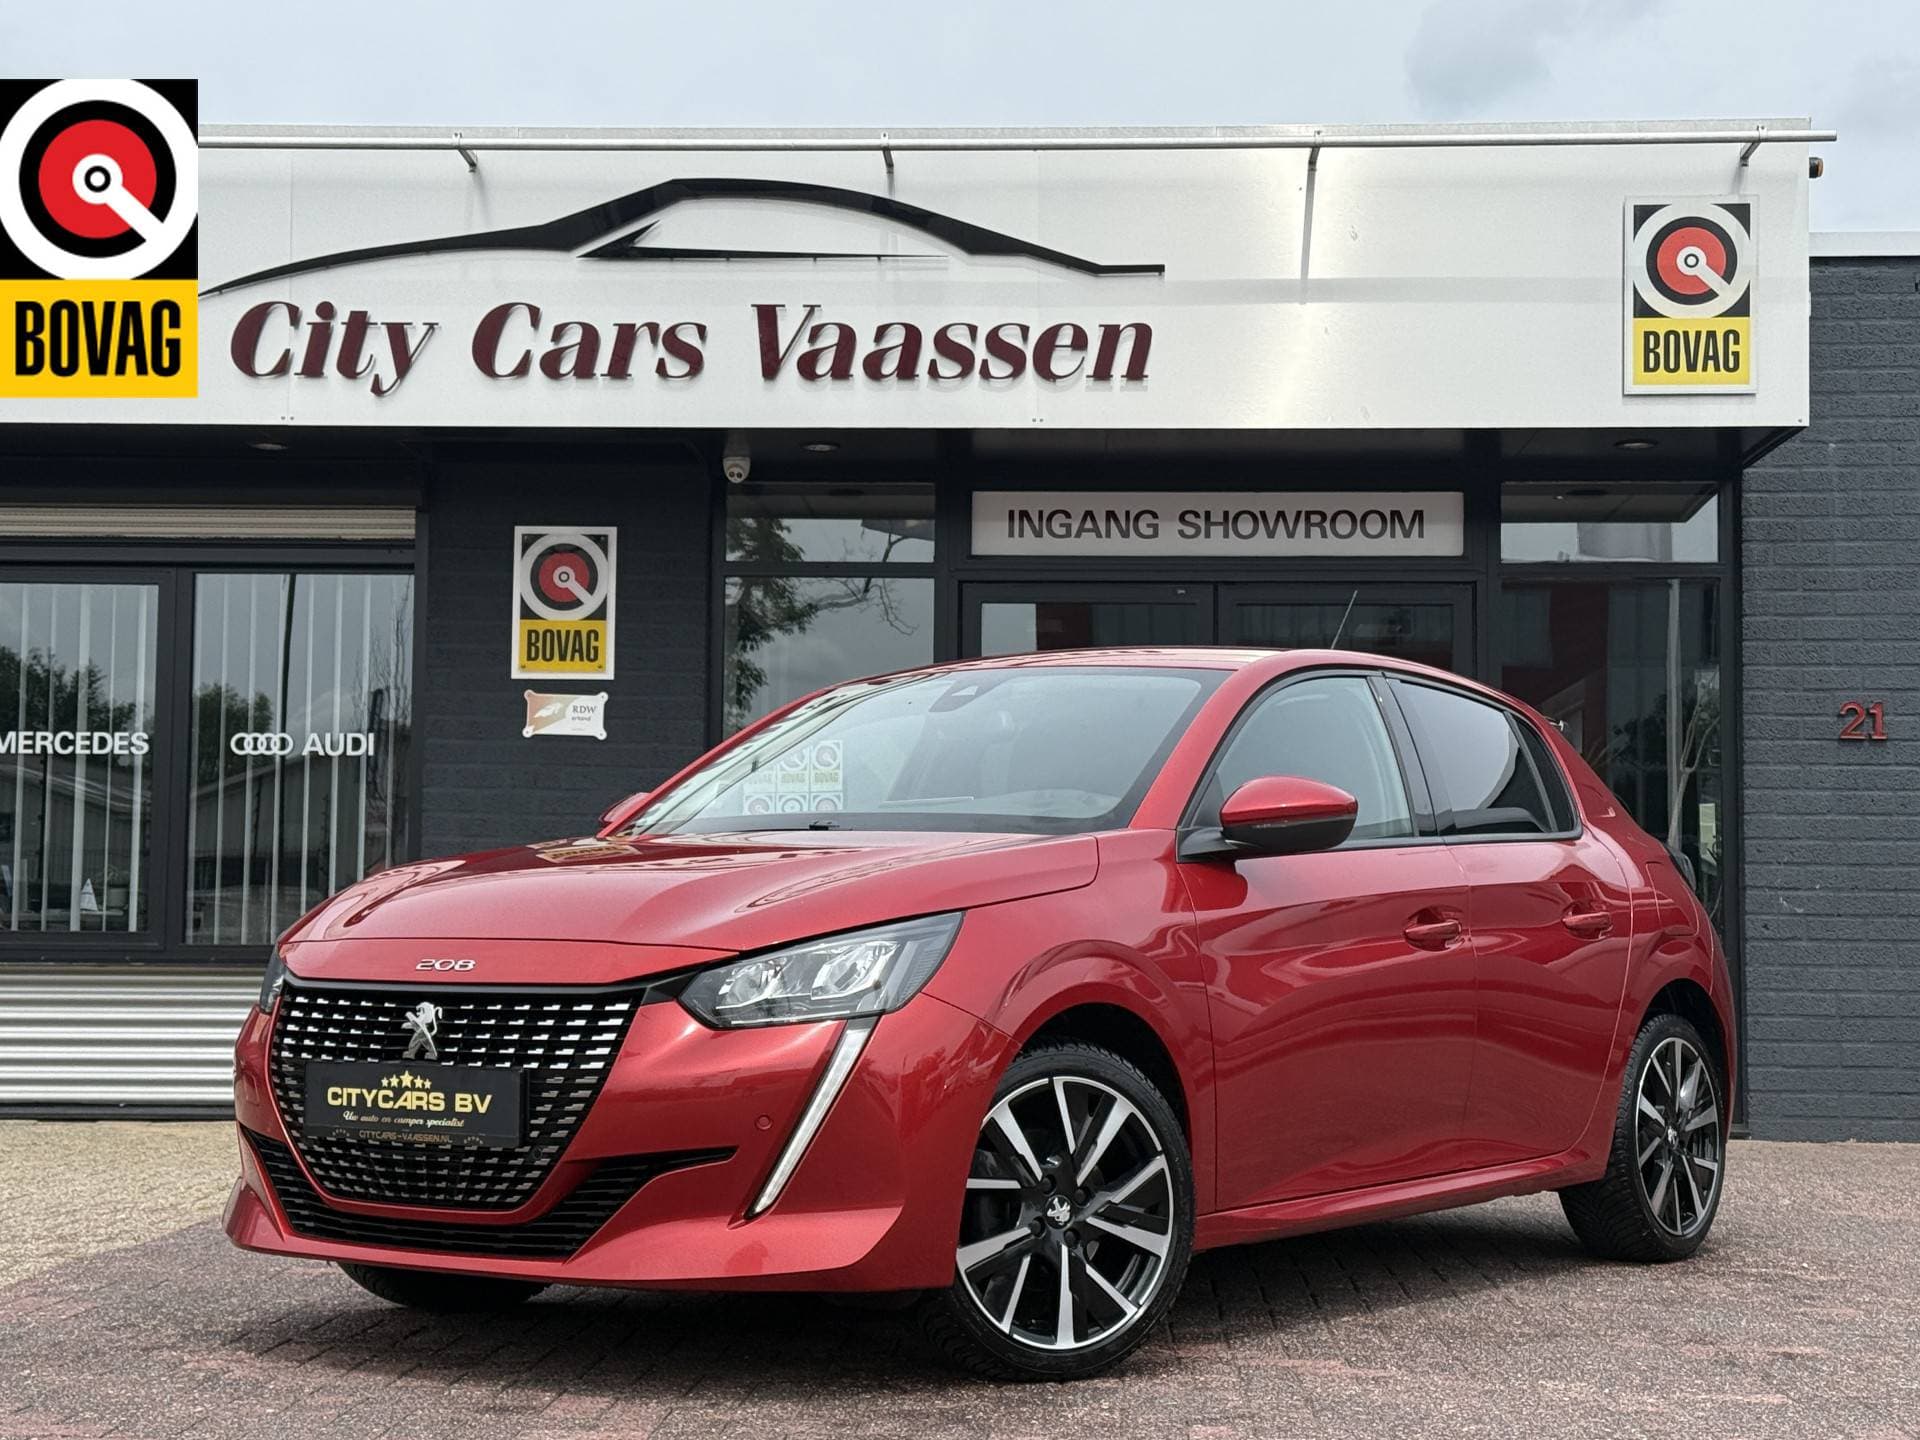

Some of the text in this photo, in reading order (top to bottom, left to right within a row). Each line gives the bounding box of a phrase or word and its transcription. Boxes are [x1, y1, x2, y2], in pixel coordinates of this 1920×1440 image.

[230, 301, 1153, 397] City Cars Vaassen
[1643, 329, 1740, 373] BOVAG
[1007, 509, 1425, 539] INGANG SHOWROOM
[526, 629, 599, 662] BOVAG
[572, 705, 598, 714] RDW
[1840, 702, 1888, 739] 21
[0, 731, 149, 755] MERCEDES
[302, 733, 375, 757] AUDI
[416, 958, 476, 972] 208
[327, 1087, 493, 1114] CITYCARS BV
[360, 1114, 380, 1123] auto
[394, 1117, 424, 1127] camper
[426, 1117, 465, 1129] specialist
